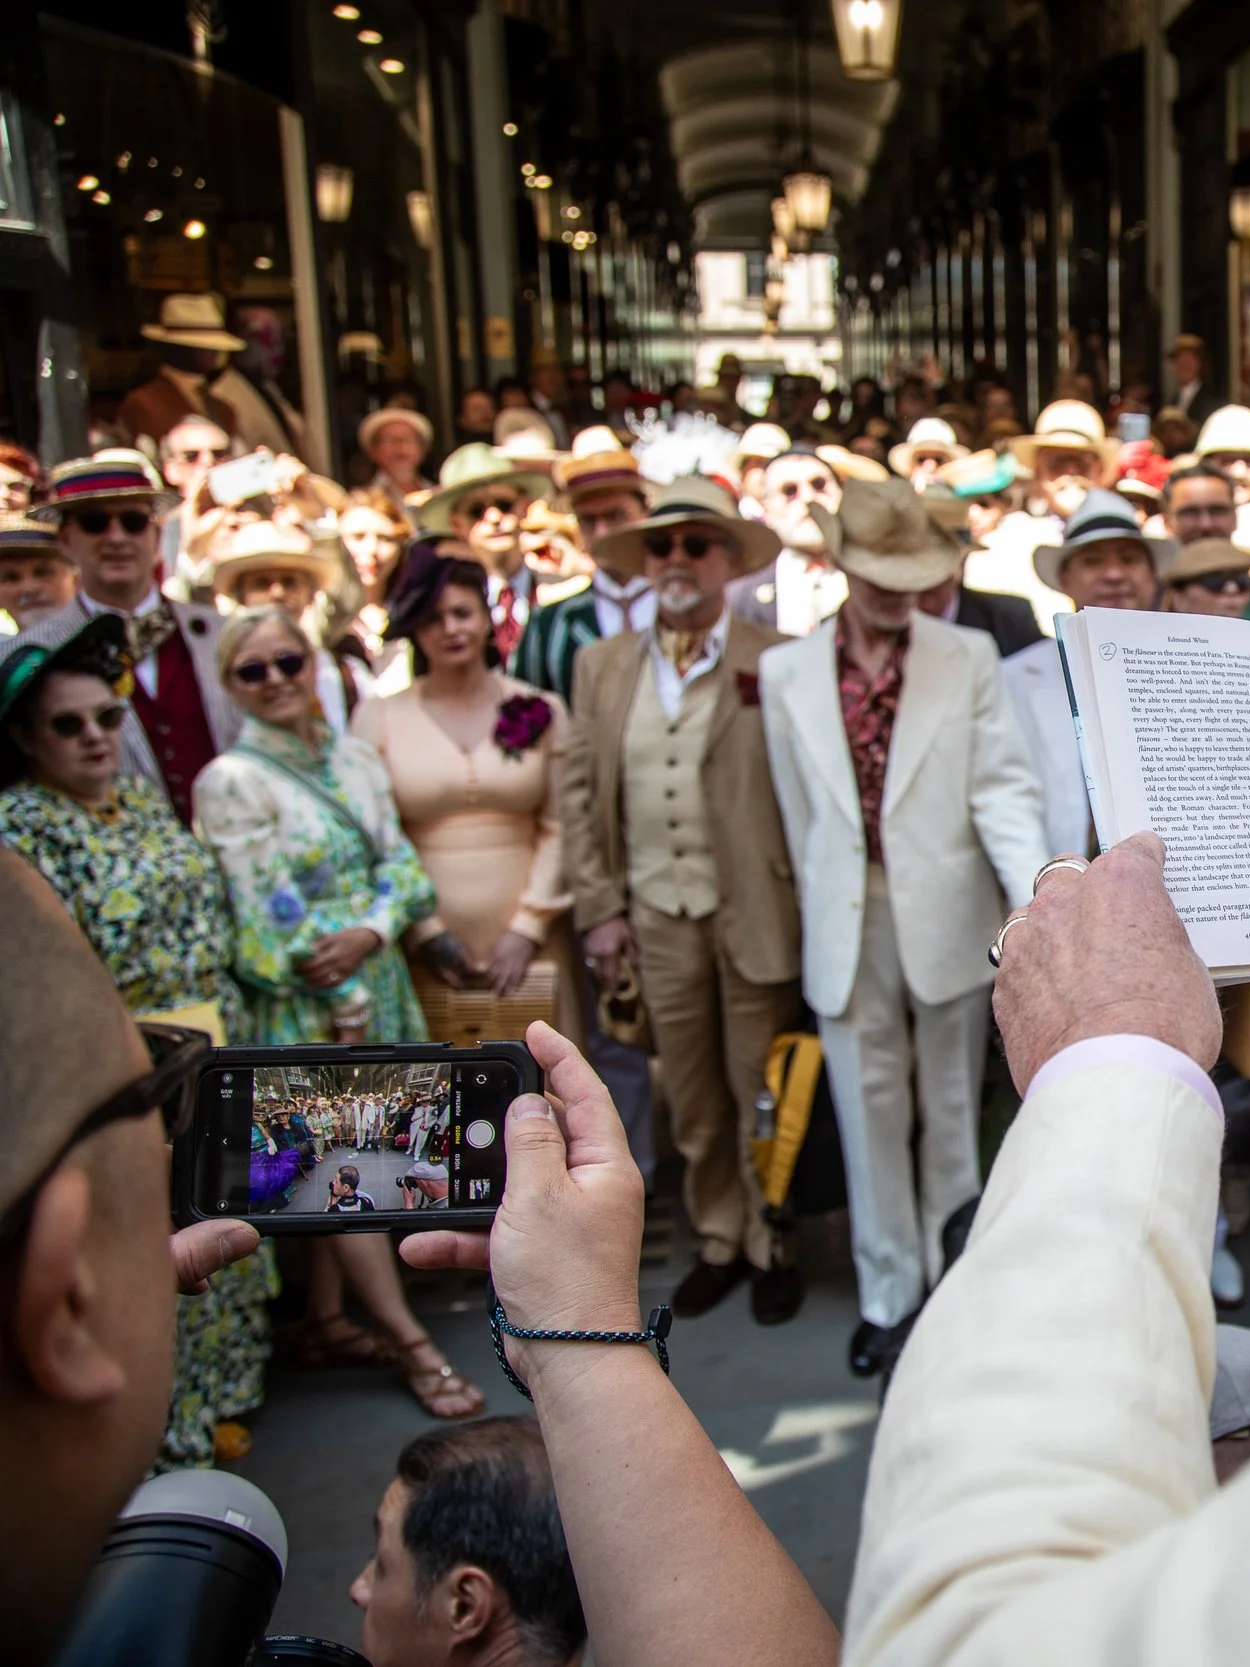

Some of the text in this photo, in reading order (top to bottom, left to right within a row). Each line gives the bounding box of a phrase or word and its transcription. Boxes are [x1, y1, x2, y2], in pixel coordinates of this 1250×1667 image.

[1179, 706, 1198, 715] along
[1196, 754, 1216, 763] happy
[1141, 764, 1156, 773] edge
[1158, 794, 1172, 803] dog
[1150, 815, 1183, 823] foreigners
[1200, 813, 1215, 822] they
